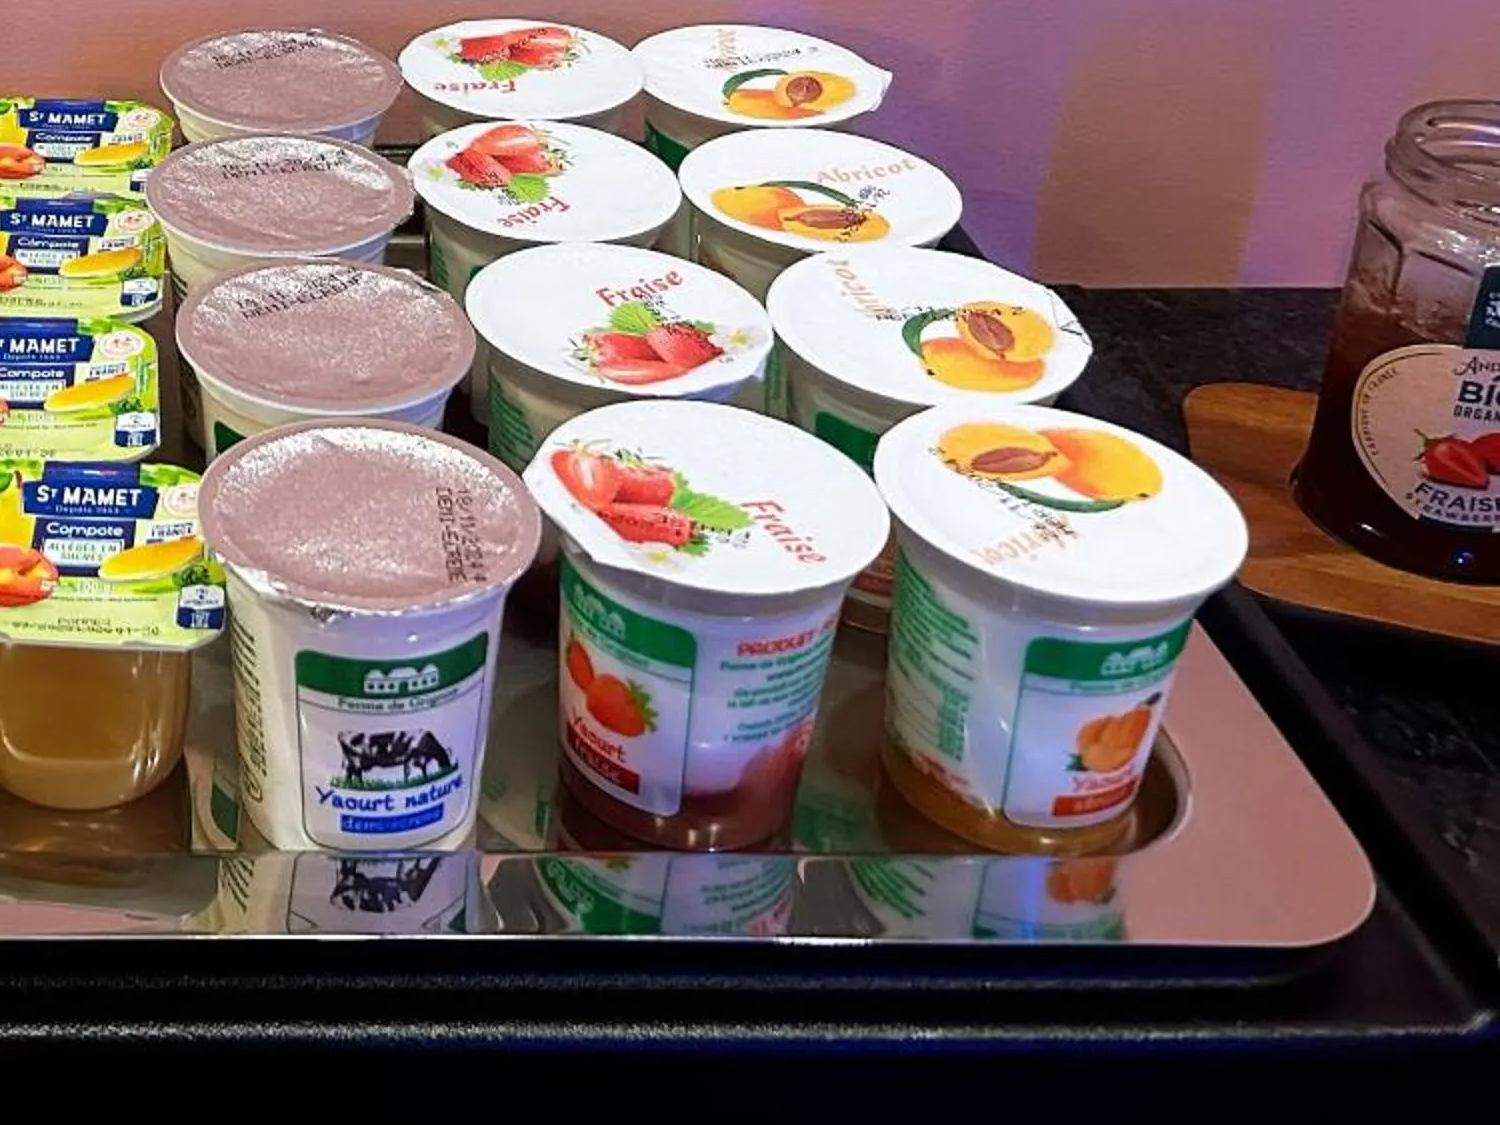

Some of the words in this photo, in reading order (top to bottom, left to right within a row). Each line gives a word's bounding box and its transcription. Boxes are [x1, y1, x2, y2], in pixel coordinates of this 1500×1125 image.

[433, 79, 516, 94] Fraise
[47, 113, 107, 125] MAMET
[816, 159, 917, 185] Abricot
[31, 214, 95, 228] MAMET
[497, 196, 571, 227] Fraise
[596, 267, 684, 307] Fraise
[9, 337, 80, 354] MAMET
[63, 486, 142, 507] MAMET
[46, 522, 124, 539] Compote
[740, 499, 827, 566] Fraise
[315, 786, 395, 812] Yaourt
[405, 776, 463, 808] nature
